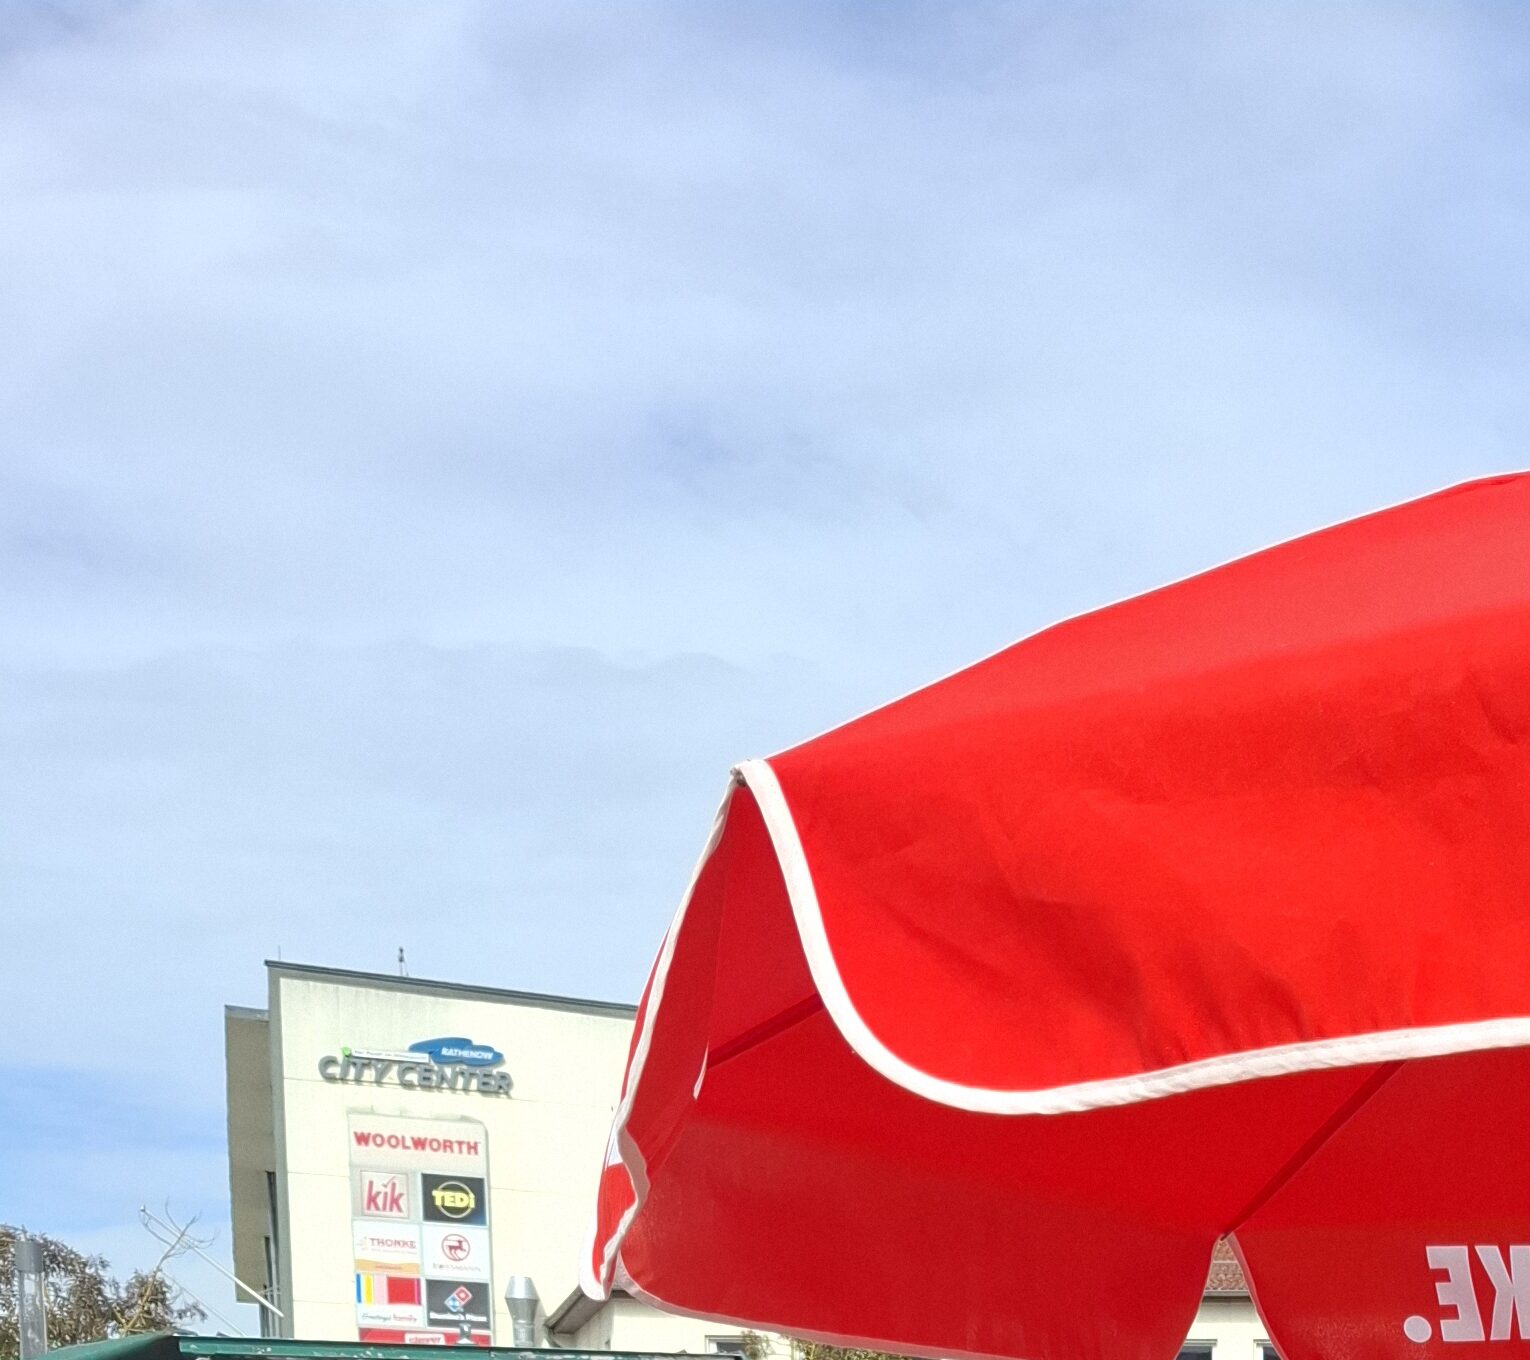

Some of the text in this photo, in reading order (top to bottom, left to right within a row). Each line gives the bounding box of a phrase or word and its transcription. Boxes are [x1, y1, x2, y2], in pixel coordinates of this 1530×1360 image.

[442, 1046, 494, 1060] RATHENOW
[318, 1053, 514, 1099] CITY CENTER
[353, 1131, 480, 1156] WOOLWORTH
[431, 1189, 476, 1208] TEDi
